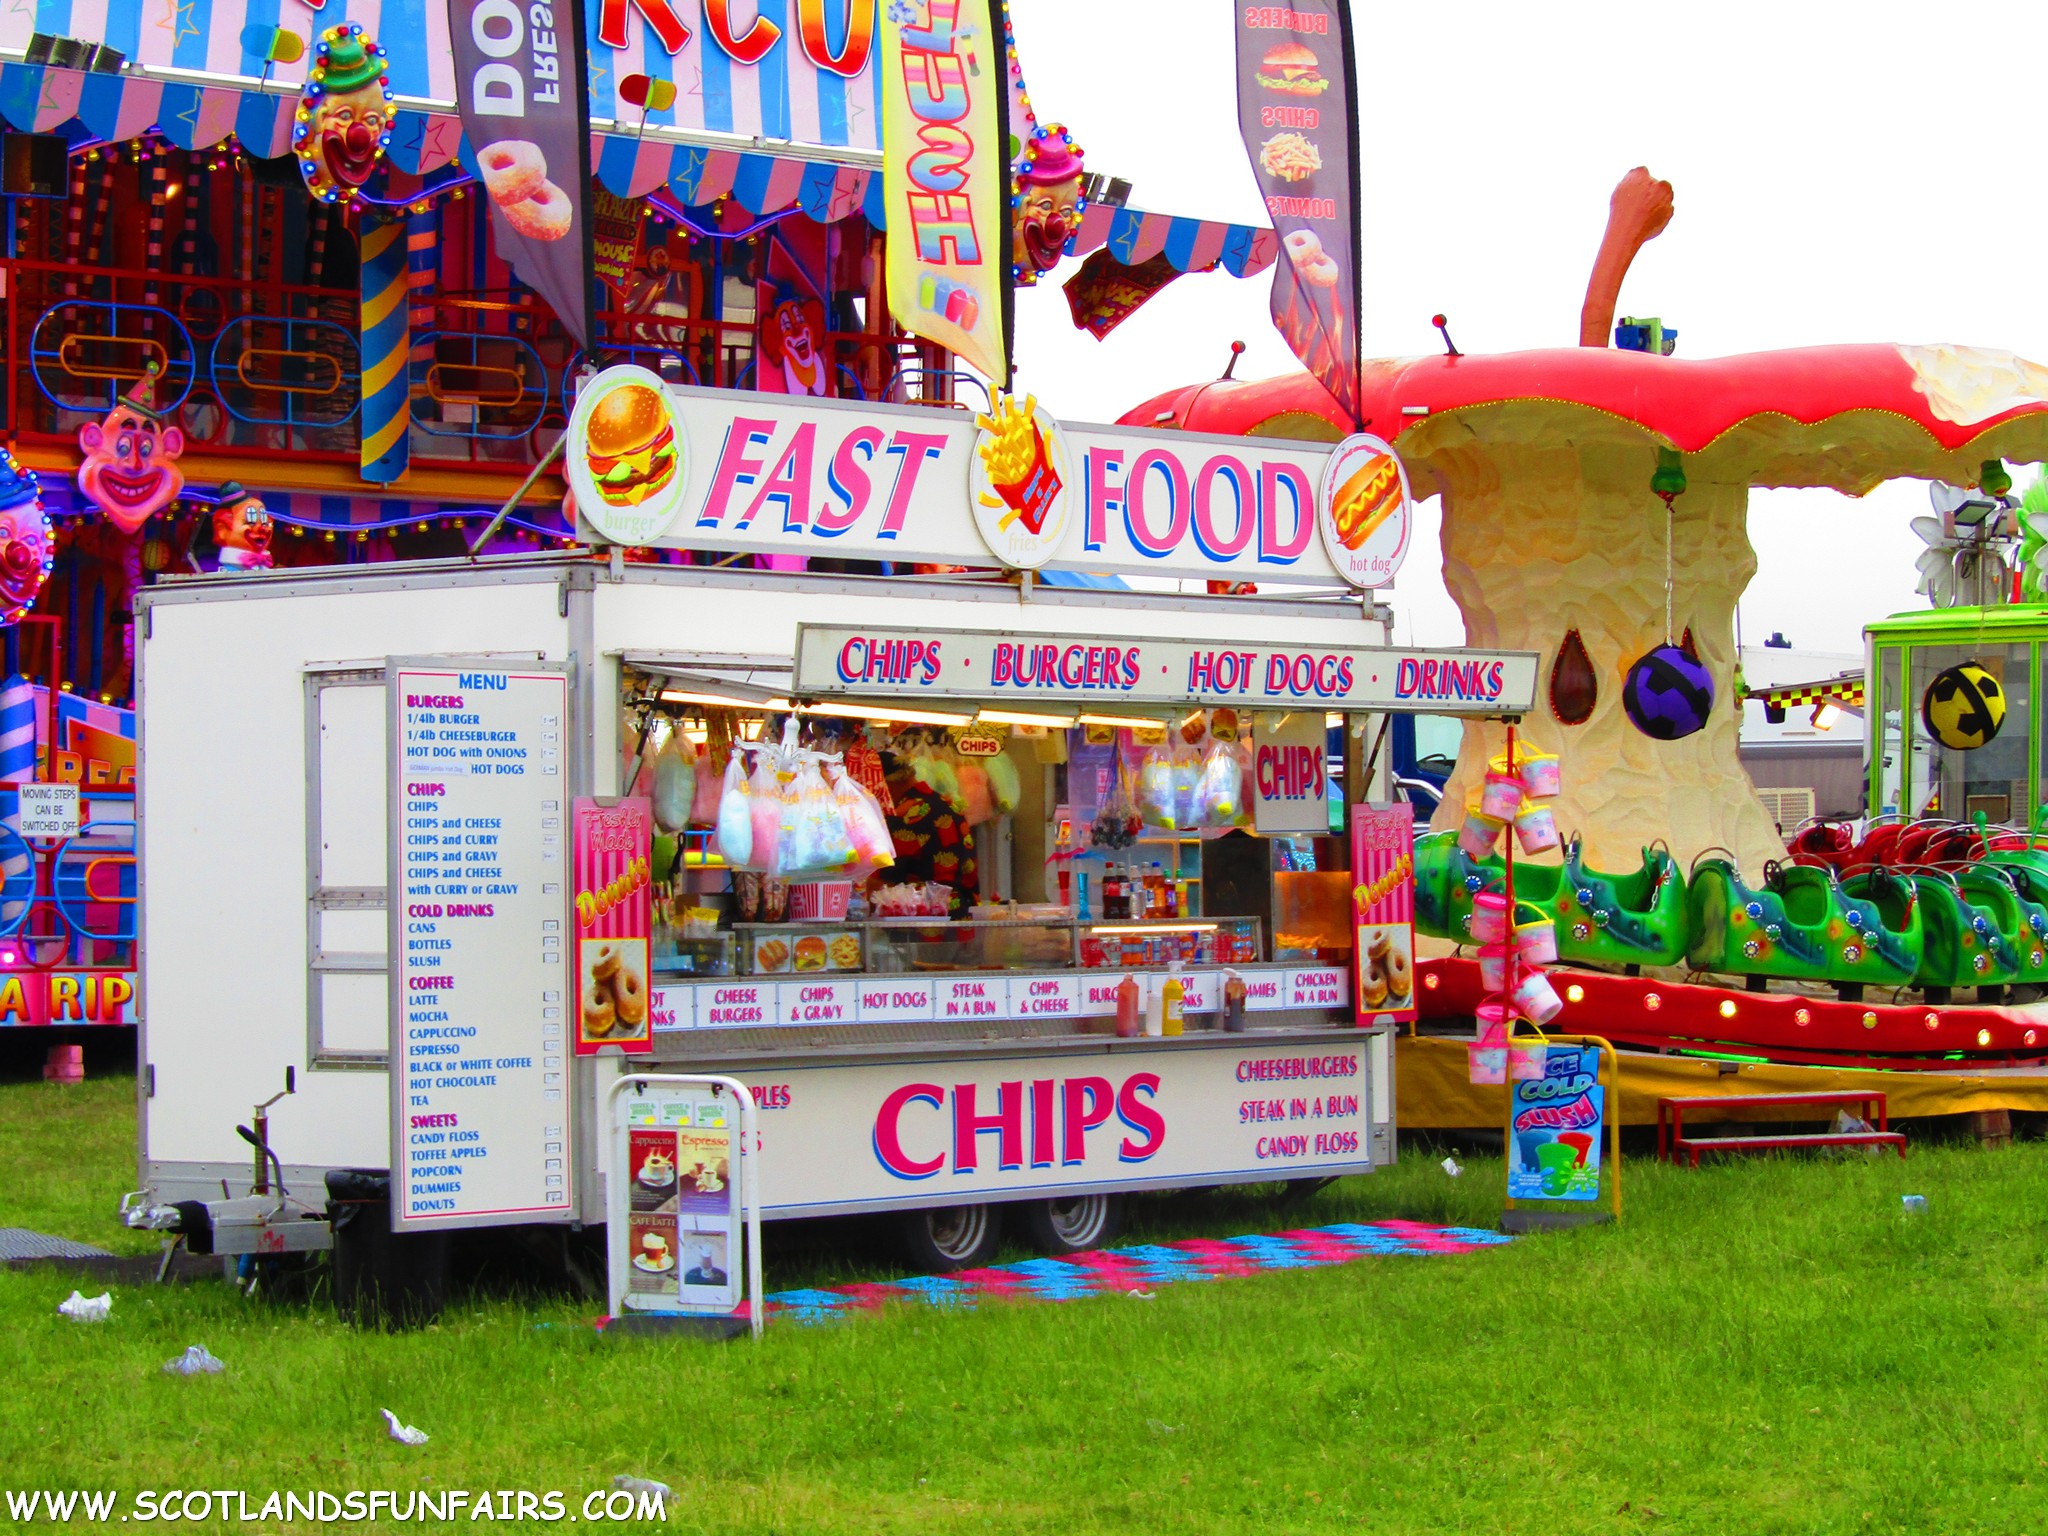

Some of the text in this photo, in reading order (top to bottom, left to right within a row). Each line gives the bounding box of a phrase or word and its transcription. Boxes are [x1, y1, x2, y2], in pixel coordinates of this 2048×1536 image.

[695, 415, 1314, 566] FAST FOOD
[604, 510, 656, 536] burger
[1008, 533, 1038, 554] fries
[1350, 555, 1391, 576] hot dog
[837, 636, 1505, 702] CHIPS BURGERS HOT DOGS DRINKS
[459, 673, 508, 690] MENU
[407, 695, 464, 709] BURGERS
[407, 713, 480, 725] 1/4lb BURGER
[407, 730, 516, 742] 1/4lb CHEESEBURGER
[407, 746, 527, 758] HOT DOG with ONIONS
[960, 741, 996, 753] CHIPS
[471, 764, 525, 775] HOT DOGS
[1257, 744, 1323, 801] CHIPS
[22, 788, 76, 800] MOVING STEPS
[407, 783, 446, 796] CHIPS
[35, 805, 63, 815] CAN BE
[407, 801, 438, 812] CHIPS
[22, 821, 76, 832] SWITCHED OFF
[407, 818, 502, 829] CHIPS and CHEESE
[581, 807, 643, 836] Freshly
[1357, 811, 1407, 836] Freshly
[407, 835, 498, 845] CHIPS and CURRY
[591, 830, 635, 852] Made
[1365, 832, 1400, 851] Made
[407, 851, 498, 862] CHIPS and GRAVY
[408, 868, 502, 878] CHIPS and CHEESE
[408, 884, 518, 895] with CURRY or GRAVY
[575, 855, 649, 929] Donuts
[1352, 852, 1413, 917] Donuts
[408, 904, 494, 918] COLD DRINKS
[408, 923, 436, 933] CANS
[408, 939, 452, 950] BOTTLES
[408, 956, 441, 967] SLUSH
[409, 976, 454, 990] COFFEE
[1182, 977, 1195, 992] OT
[1294, 973, 1338, 988] CHICKEN
[800, 986, 834, 1003] CHIPS
[952, 983, 985, 998] STEAK
[1029, 981, 1059, 996] CHIPS
[1293, 988, 1338, 1004] IN A BUN
[0, 976, 139, 1022] A RIP
[409, 995, 438, 1005] LATTE
[714, 989, 757, 1005] CHEESE
[863, 992, 927, 1009] HOT DOGS
[1182, 993, 1203, 1007] NKS
[946, 1000, 996, 1016] IN A BUN
[1020, 997, 1069, 1013] & CHEESE
[409, 1011, 448, 1022] MOCHA
[651, 1010, 676, 1026] NKS
[709, 1007, 763, 1023] BURGERS
[790, 1005, 843, 1021] & GRAVY
[409, 1027, 476, 1039] CAPPUCCINO
[409, 1044, 460, 1056] ESPRESSO
[410, 1057, 532, 1073] BLACK or WHITE COFFEE
[1236, 1055, 1358, 1083] CHEESEBURGERS
[1546, 1054, 1579, 1076] CE
[410, 1075, 497, 1089] HOT CHOCOLATE
[1520, 1074, 1594, 1100] COLD
[410, 1095, 429, 1106] TEA
[1239, 1095, 1358, 1124] STEAK IN A BUN
[1516, 1094, 1598, 1133] SLUSH
[410, 1113, 458, 1129] SWEETS
[872, 1072, 1166, 1181] CHIPS
[411, 1131, 479, 1145] CANDY FLOSS
[629, 1134, 675, 1147] Cappuccino
[681, 1134, 729, 1150] Espresso
[1256, 1131, 1358, 1159] CANDY FLOSS
[411, 1147, 487, 1161] TOFFEE APPLES
[411, 1165, 462, 1178] POPCORN
[412, 1182, 461, 1195] DUMMIES
[412, 1199, 455, 1212] DONUTS
[652, 1216, 676, 1227] LATTE
